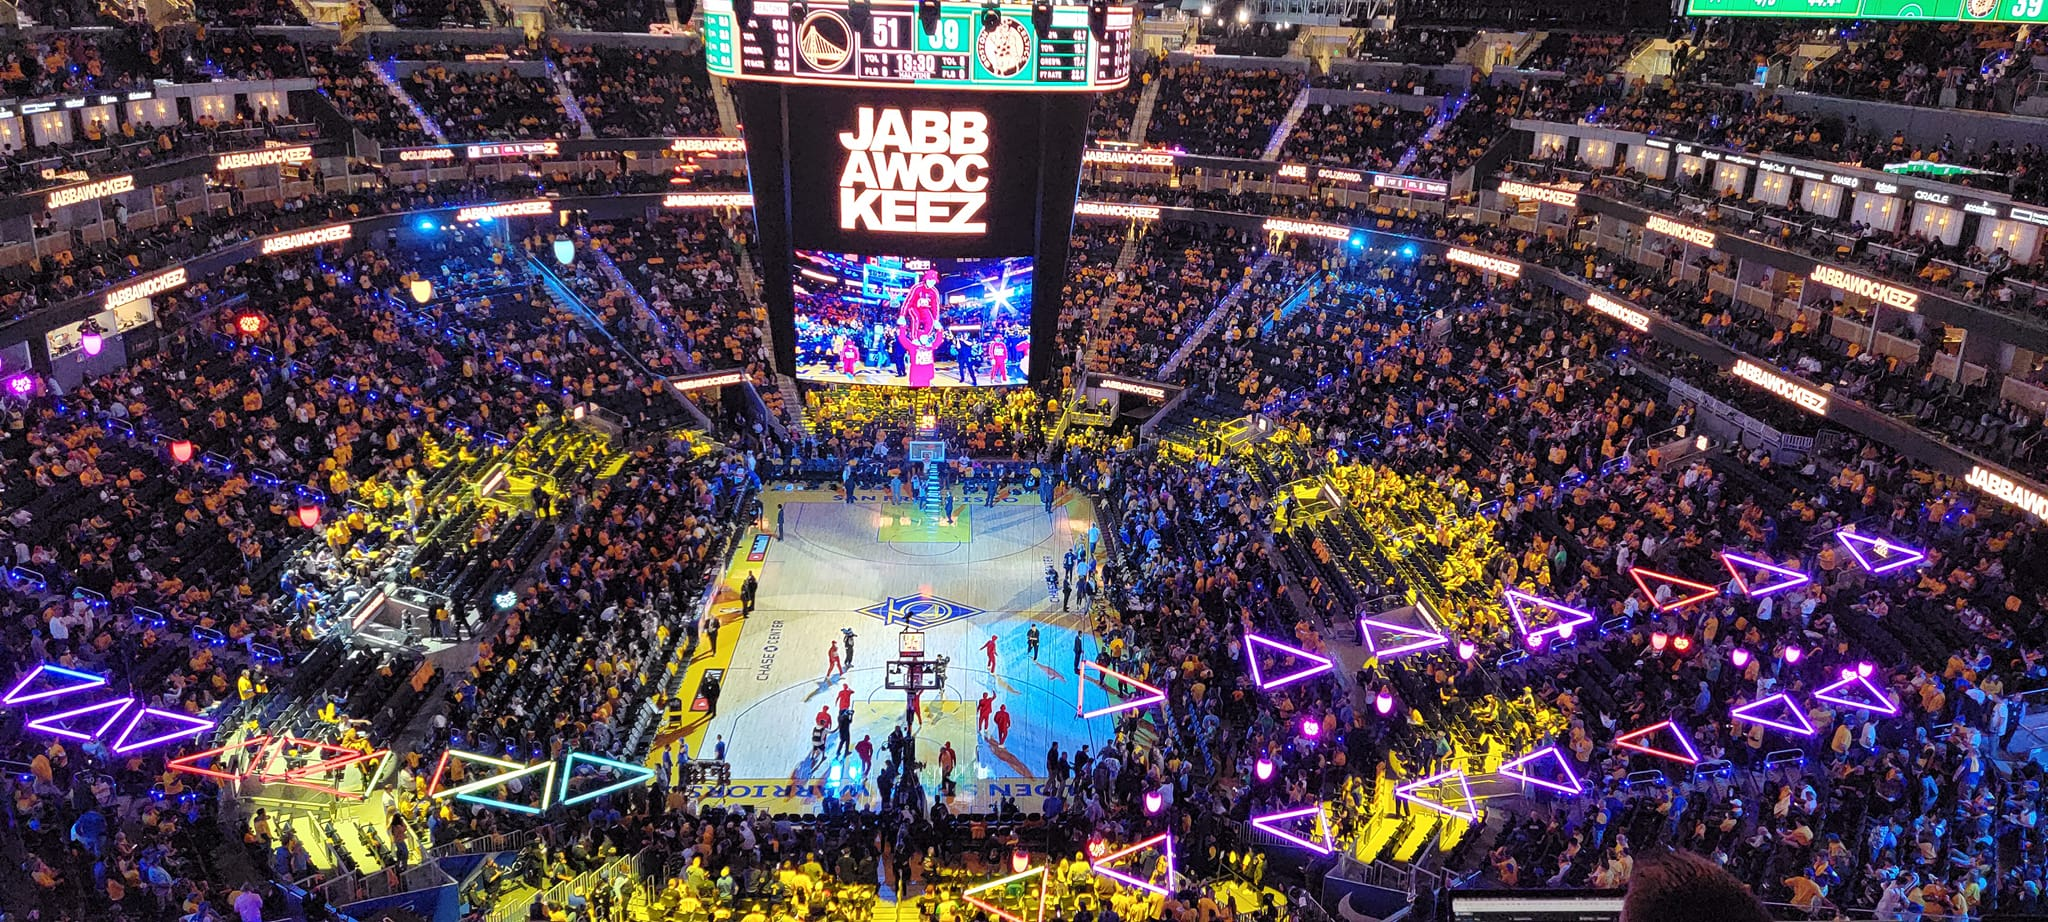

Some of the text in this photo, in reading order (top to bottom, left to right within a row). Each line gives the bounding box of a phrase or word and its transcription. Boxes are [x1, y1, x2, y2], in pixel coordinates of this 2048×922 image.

[2011, 0, 2044, 18] 39
[873, 17, 898, 48] 51
[928, 19, 959, 50] 39
[896, 54, 935, 72] 13:30
[838, 106, 990, 155] JABB
[217, 146, 312, 170] JABBAWOCKEEZ
[839, 150, 990, 192] AWOC
[1083, 151, 1174, 166] JABBAWOCKEEZ
[48, 175, 135, 209] JABBAWOCKEEZ
[1498, 181, 1577, 207] JABBAWOCKEEZ
[1915, 190, 1949, 204] ORACLE
[457, 201, 552, 222] JABBAWOCKEEZ
[840, 187, 987, 233] KEEZ
[262, 224, 351, 254] JABBAWOCKEEZ
[1262, 218, 1350, 241] JABBAWOCKEEZ
[1646, 215, 1716, 249] JABBAWOCKEEZ
[1446, 248, 1521, 278] JABBAWOCKEEZ
[104, 268, 187, 311] JABBAWOCKEEZ
[1811, 265, 1920, 312] JABBAWOCKEEZ
[1588, 293, 1650, 333] JABBAWOCKEEZ
[1733, 359, 1828, 416] JABBAWOCKEEZ
[767, 620, 784, 645] CENTER
[756, 653, 775, 681] CHASE
